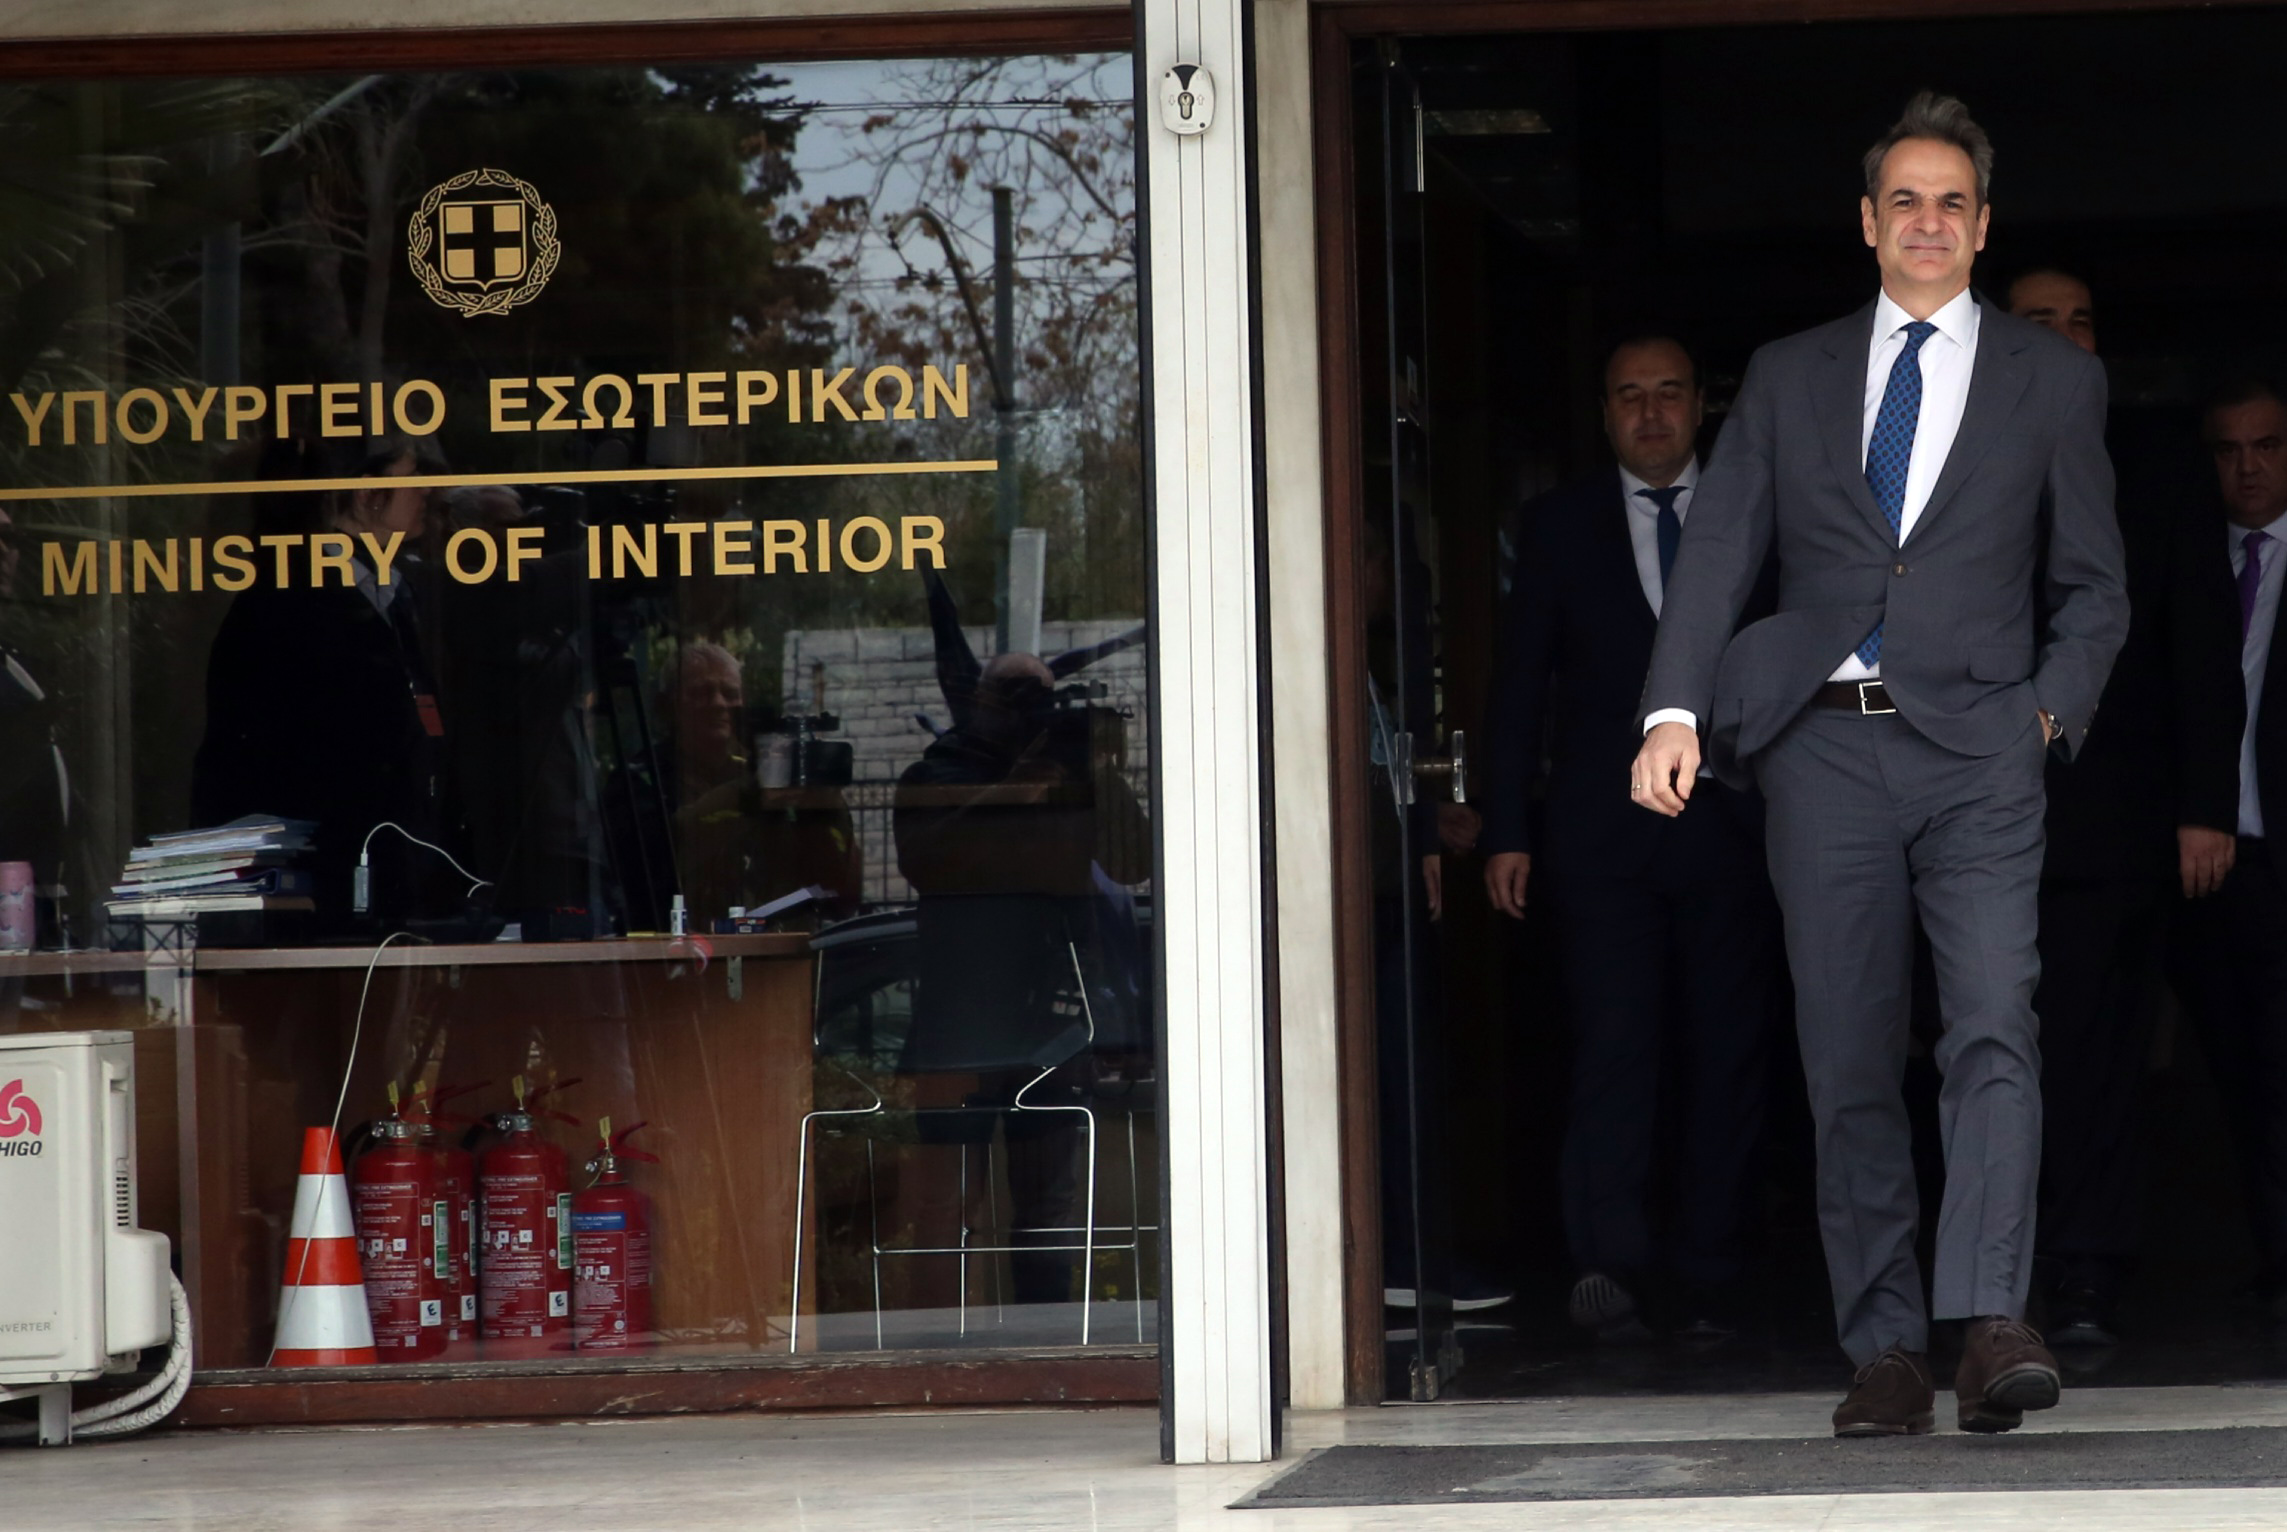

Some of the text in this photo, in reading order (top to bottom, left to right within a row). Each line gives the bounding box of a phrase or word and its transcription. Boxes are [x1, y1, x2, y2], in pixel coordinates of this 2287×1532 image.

[10, 363, 969, 446] ΥΠΟΥΡΓΕΙΟ ΕΣΩΤΕΡΙΚΩΝ
[42, 515, 947, 596] MINISTRY OF INTERIOR
